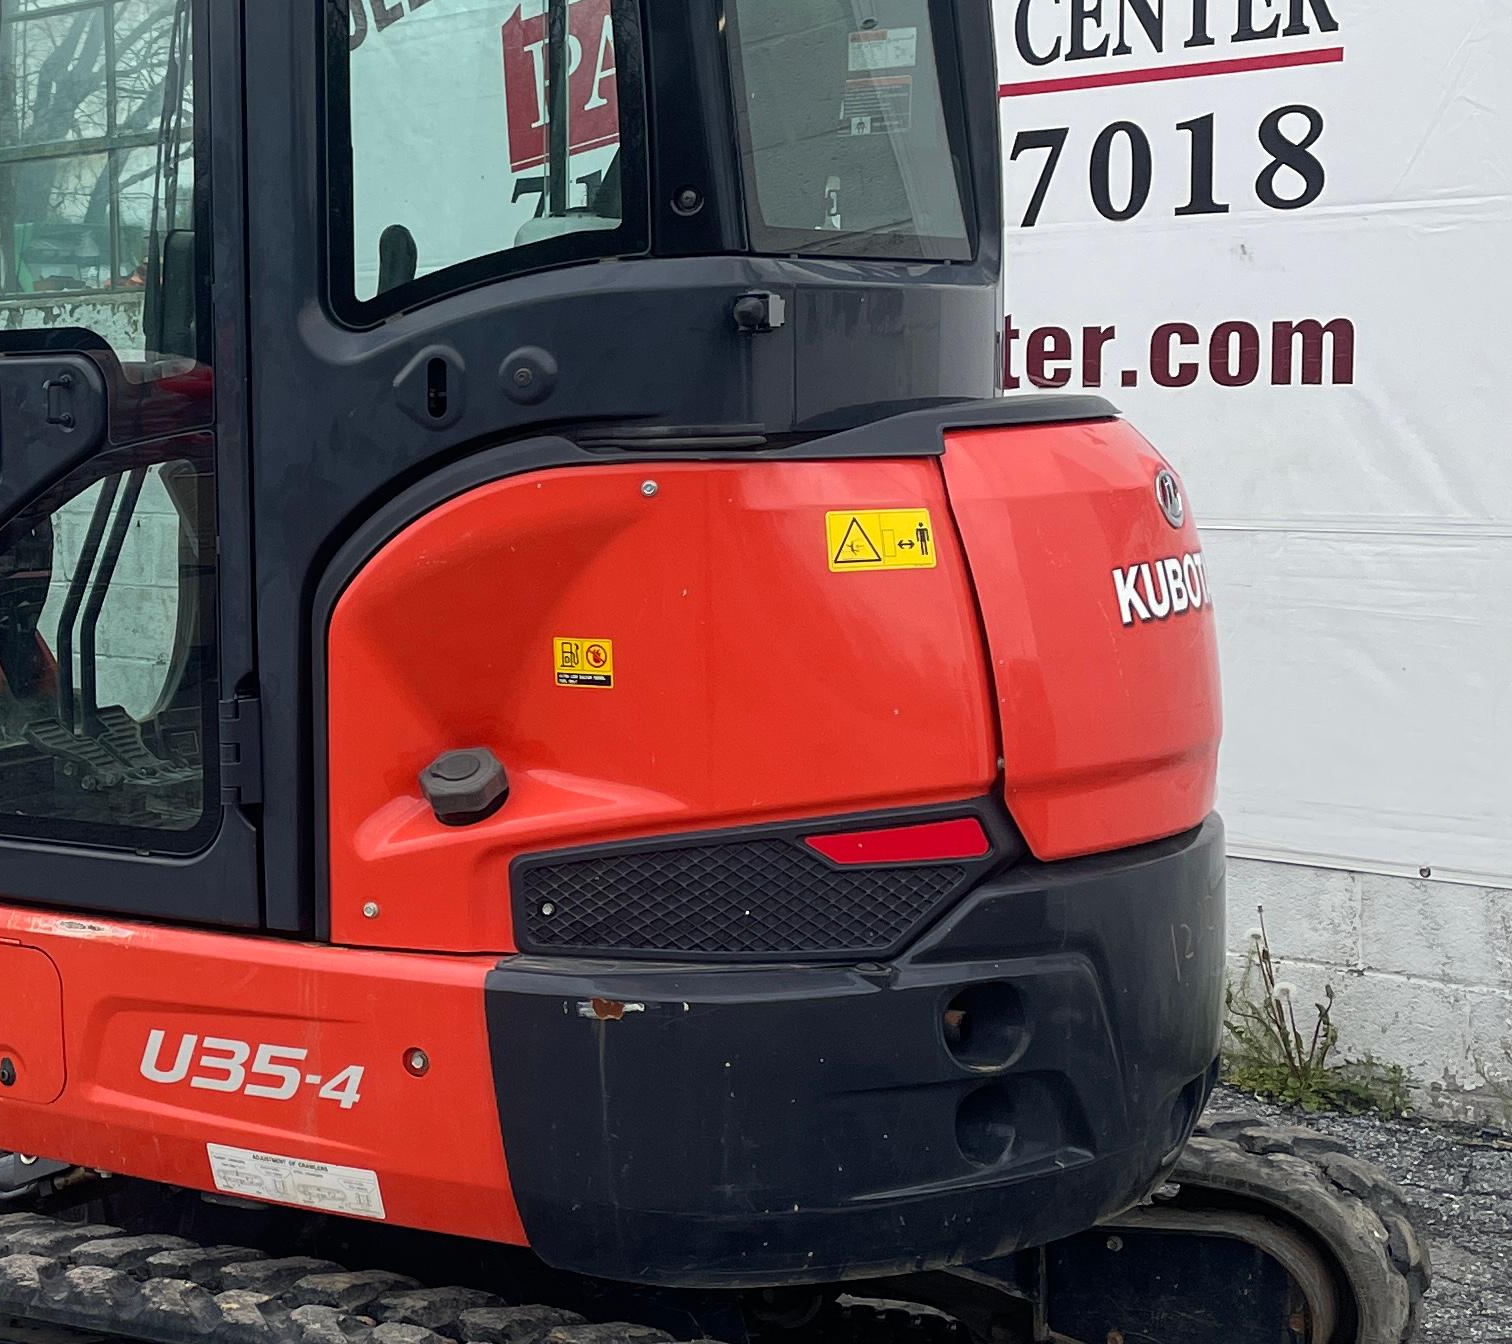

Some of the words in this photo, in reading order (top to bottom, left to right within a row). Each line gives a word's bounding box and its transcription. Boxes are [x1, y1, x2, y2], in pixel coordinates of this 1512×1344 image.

[1010, 104, 1326, 228] 7018
[1112, 552, 1210, 625] KUBOT
[140, 1029, 365, 1109] U35-4
